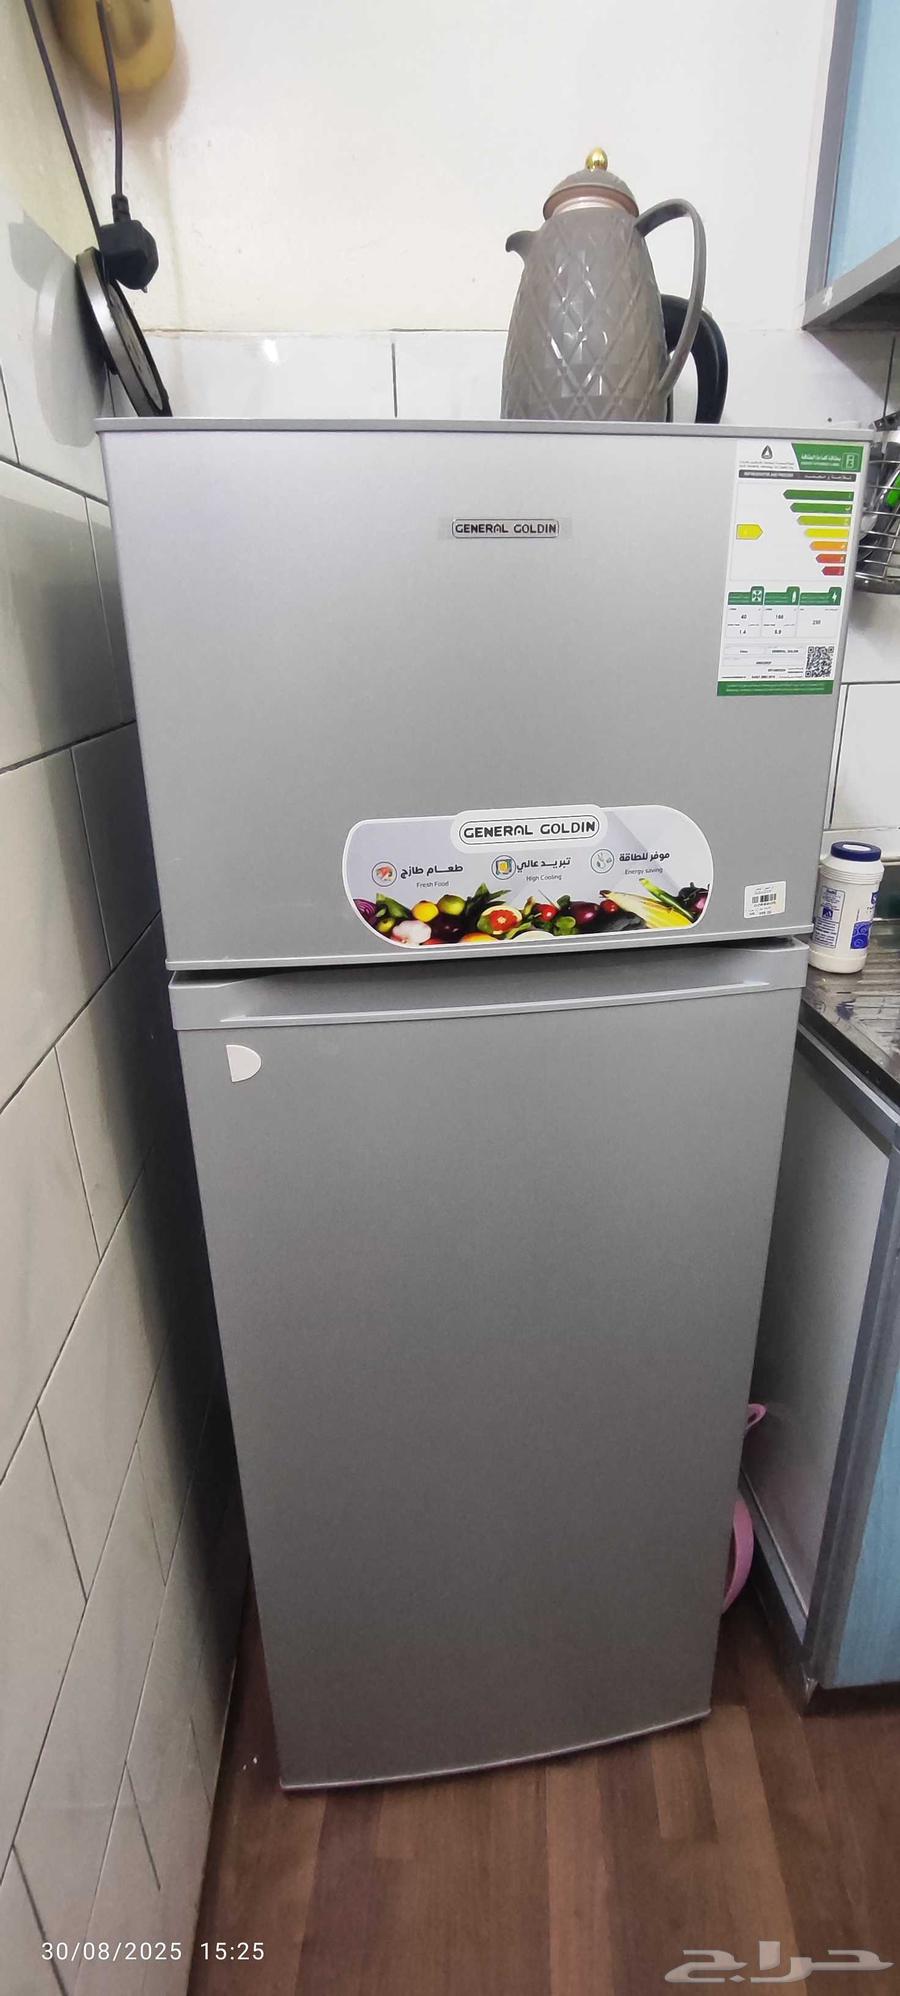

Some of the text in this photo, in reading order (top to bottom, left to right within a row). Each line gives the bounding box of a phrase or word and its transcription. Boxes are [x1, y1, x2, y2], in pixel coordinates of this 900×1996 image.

[455, 523, 557, 534] GENERAL GOLDIN
[464, 821, 595, 839] GENERAL GOLDIN
[619, 851, 670, 862] موفر للطاقة
[400, 865, 424, 880] طازج
[516, 859, 539, 873] عالي
